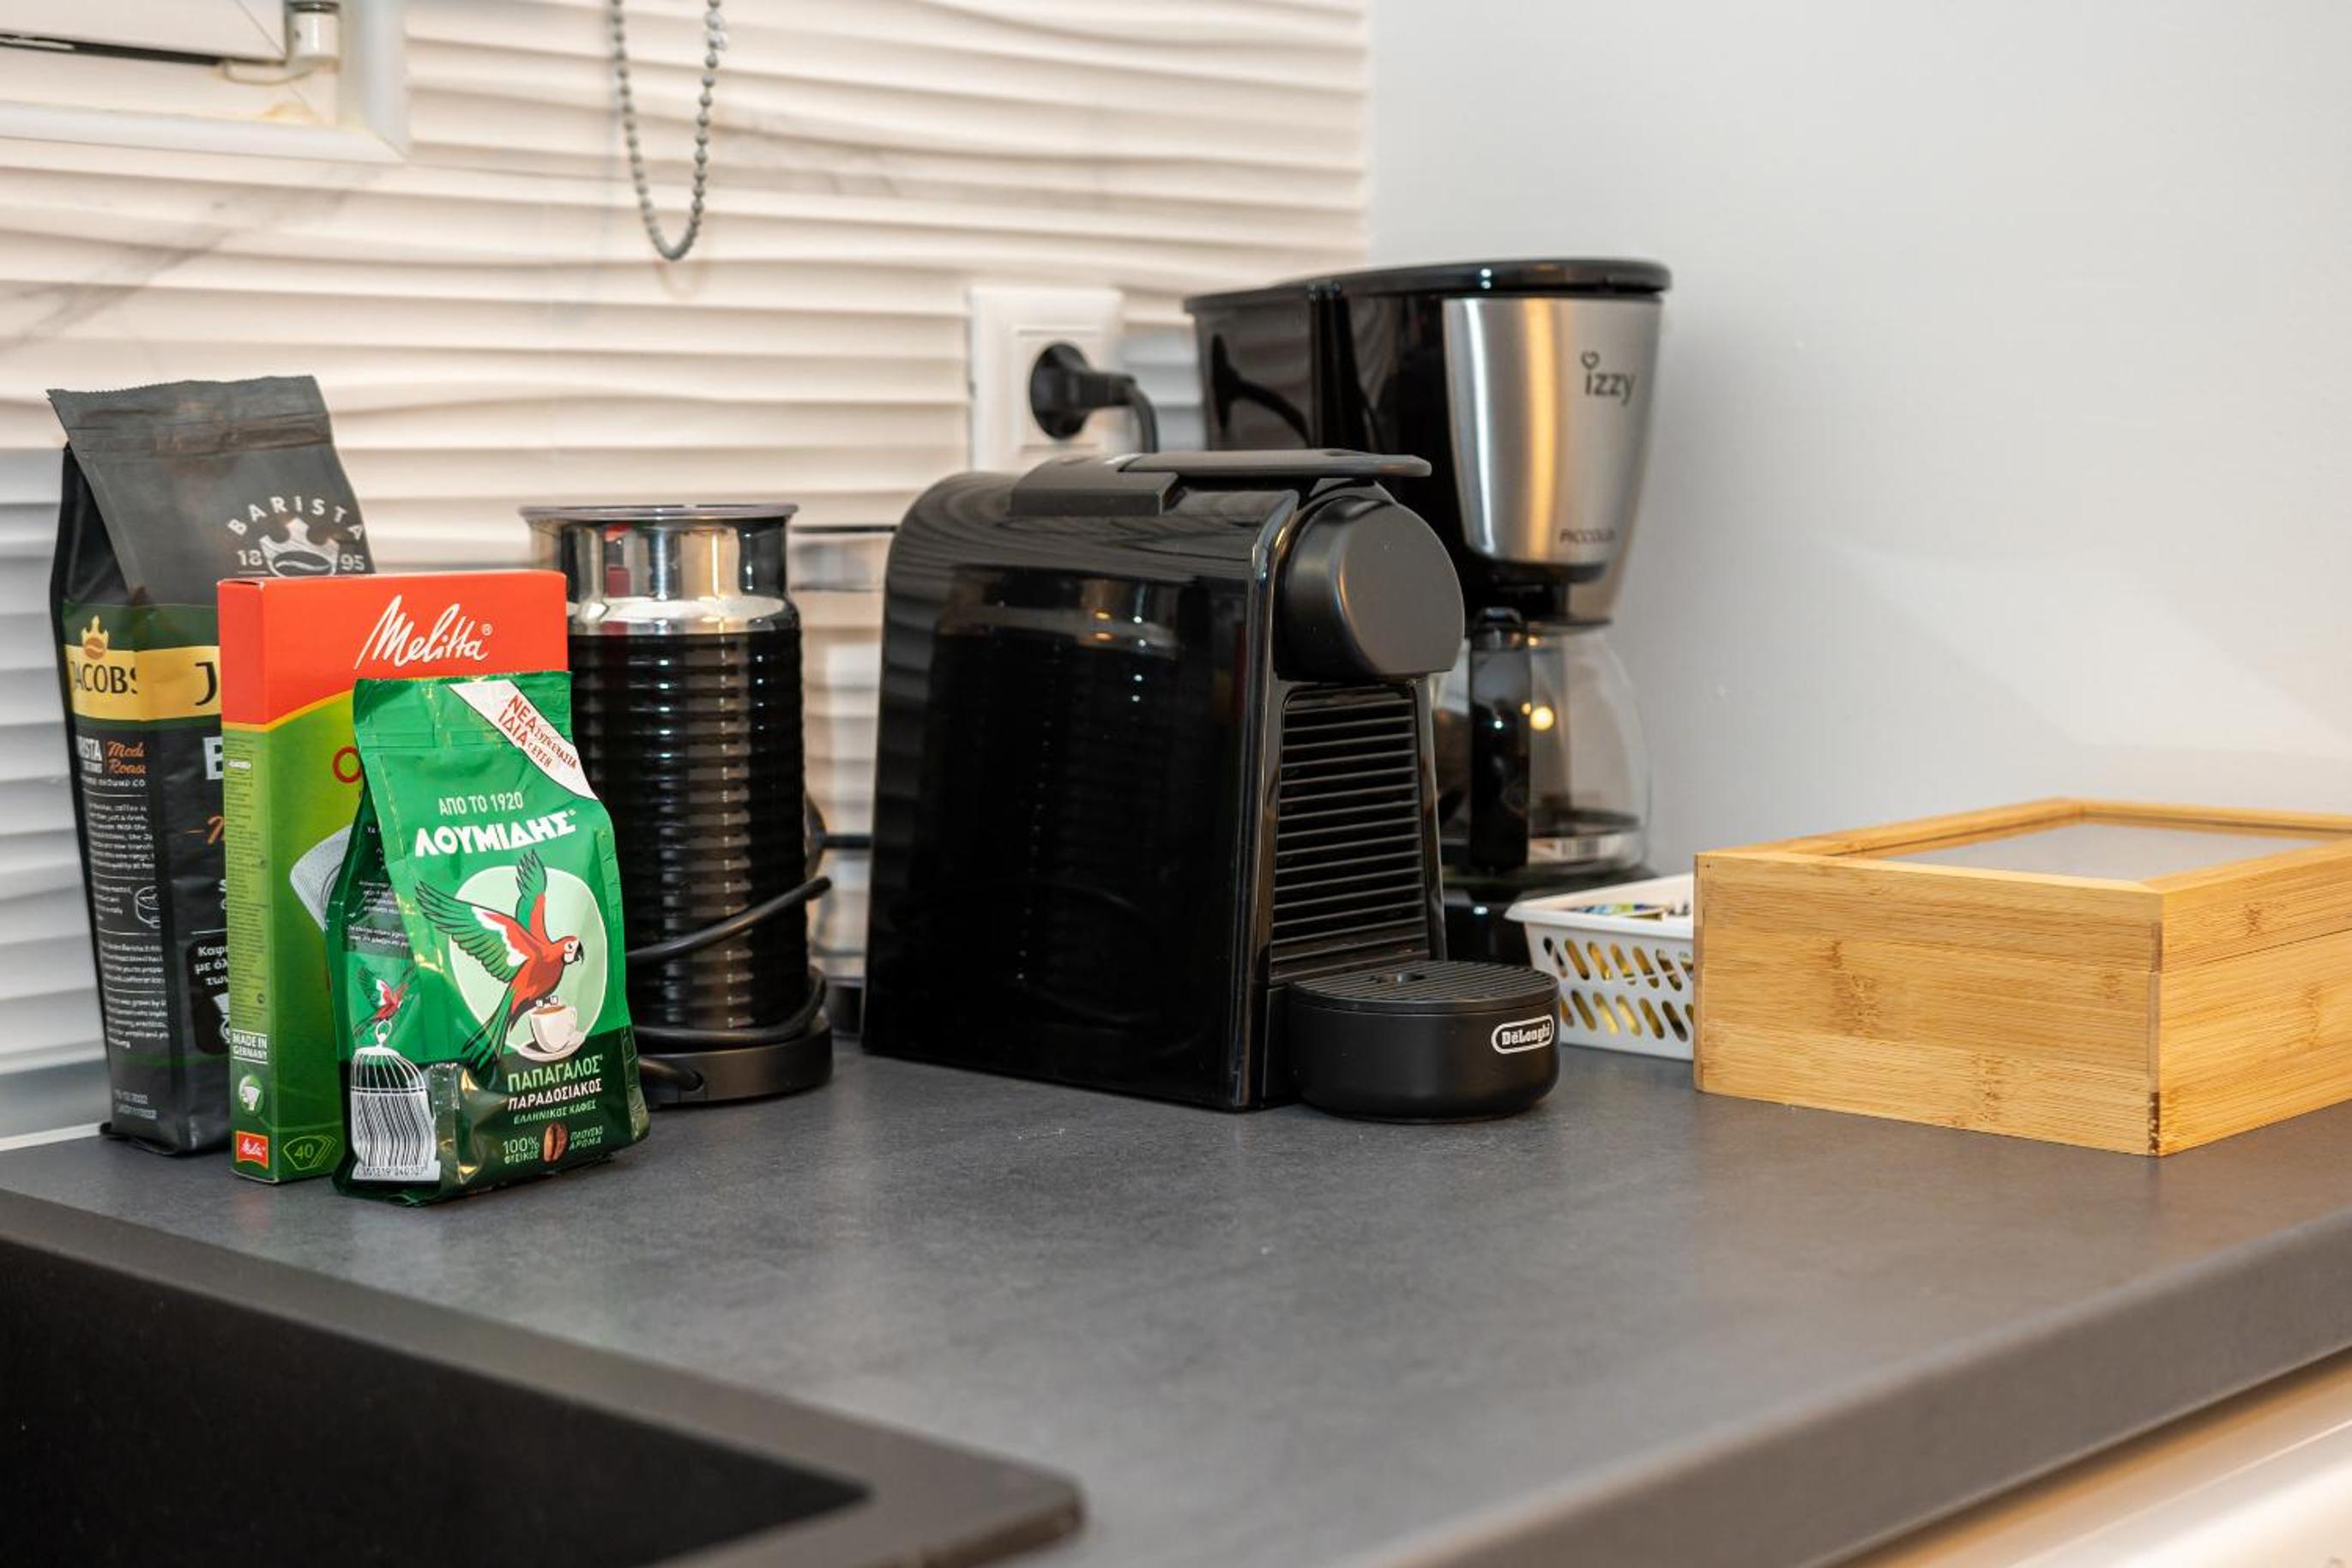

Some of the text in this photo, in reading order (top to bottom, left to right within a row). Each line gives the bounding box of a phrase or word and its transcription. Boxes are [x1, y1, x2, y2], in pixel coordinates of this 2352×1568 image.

[1583, 369, 1637, 407] izzy
[226, 495, 364, 541] BARISTA
[490, 791, 524, 811] 1920
[415, 810, 577, 857] ΛΟΥΜΙΔΗΣ
[232, 1032, 268, 1049] MADE IN
[232, 1045, 268, 1060] GERMANY
[507, 1055, 601, 1093] ΠΑΠΑΓΑΛΟΣ
[507, 1078, 602, 1111] ΠΑΡΑΔΟΣΙΑΚΟΣ
[293, 1143, 315, 1161] 40
[503, 1136, 540, 1155] 100%
